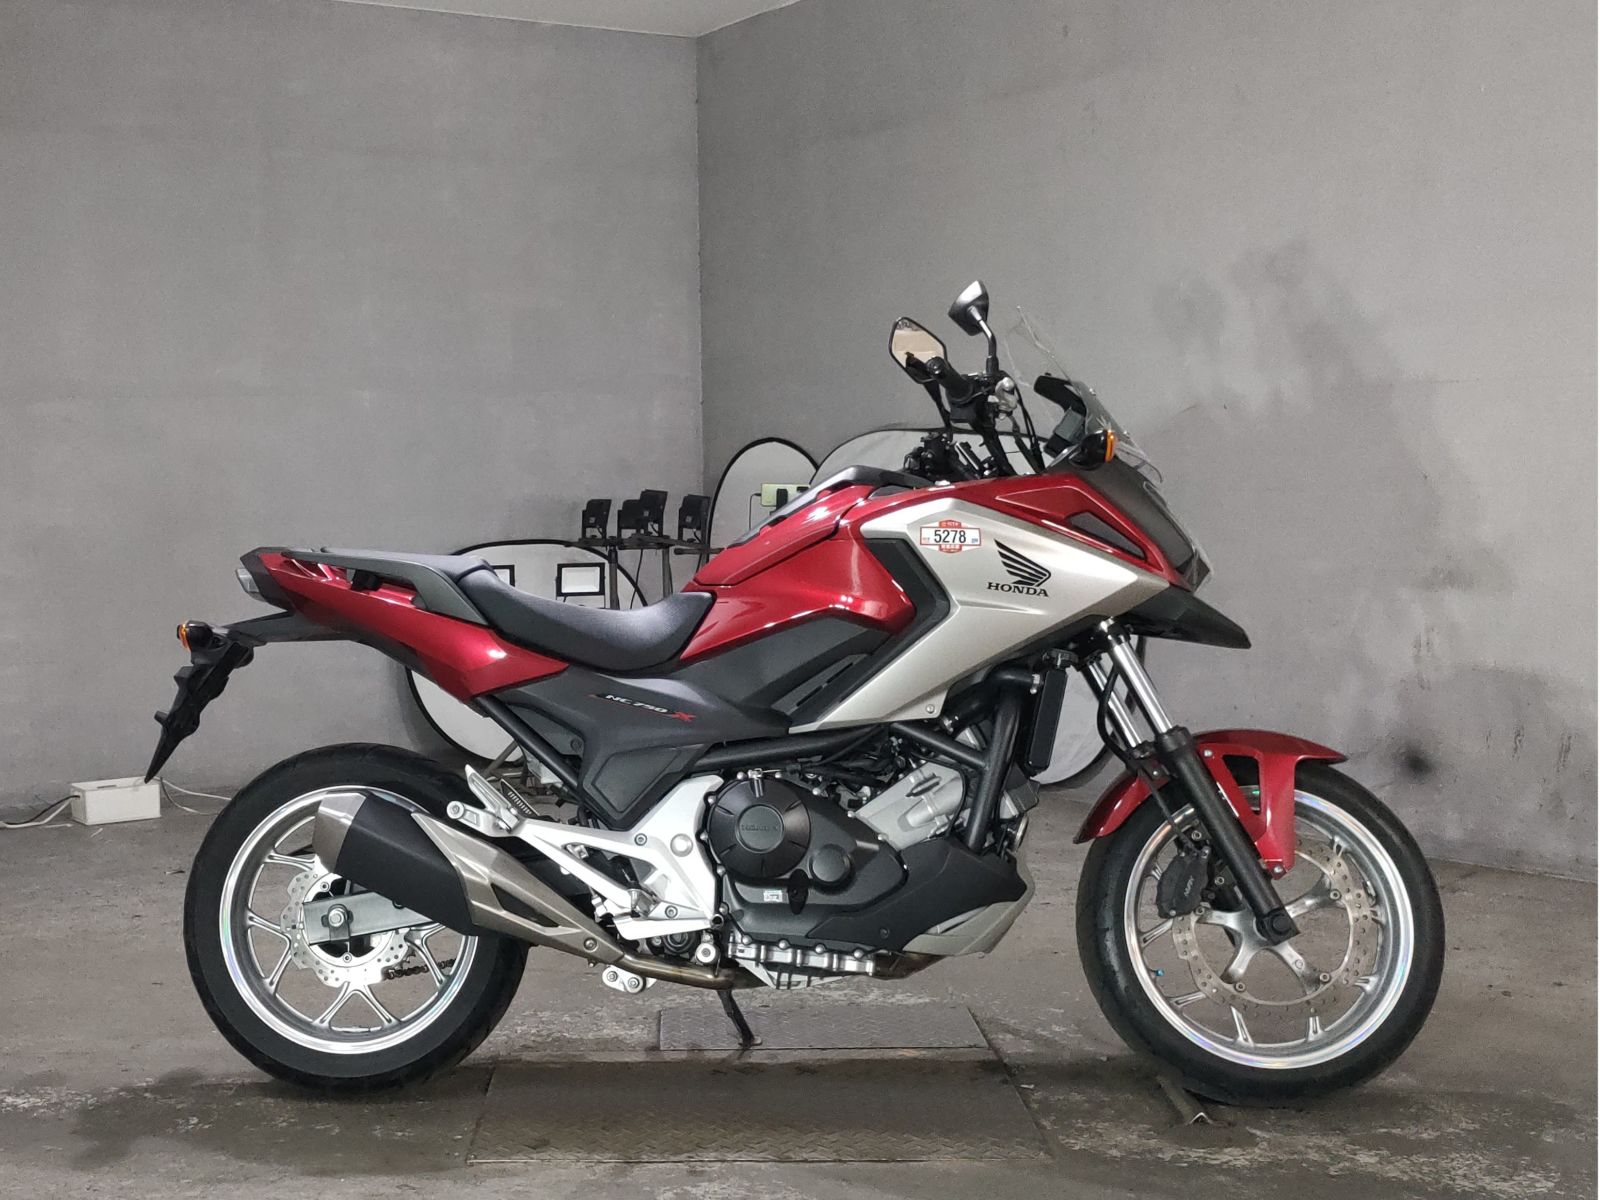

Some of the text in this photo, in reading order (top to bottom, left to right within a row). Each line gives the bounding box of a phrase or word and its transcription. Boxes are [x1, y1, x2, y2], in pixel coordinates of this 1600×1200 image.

[934, 529, 966, 543] 5278
[987, 582, 1049, 597] HONDA
[605, 694, 632, 704] NC
[633, 701, 668, 713] 750
